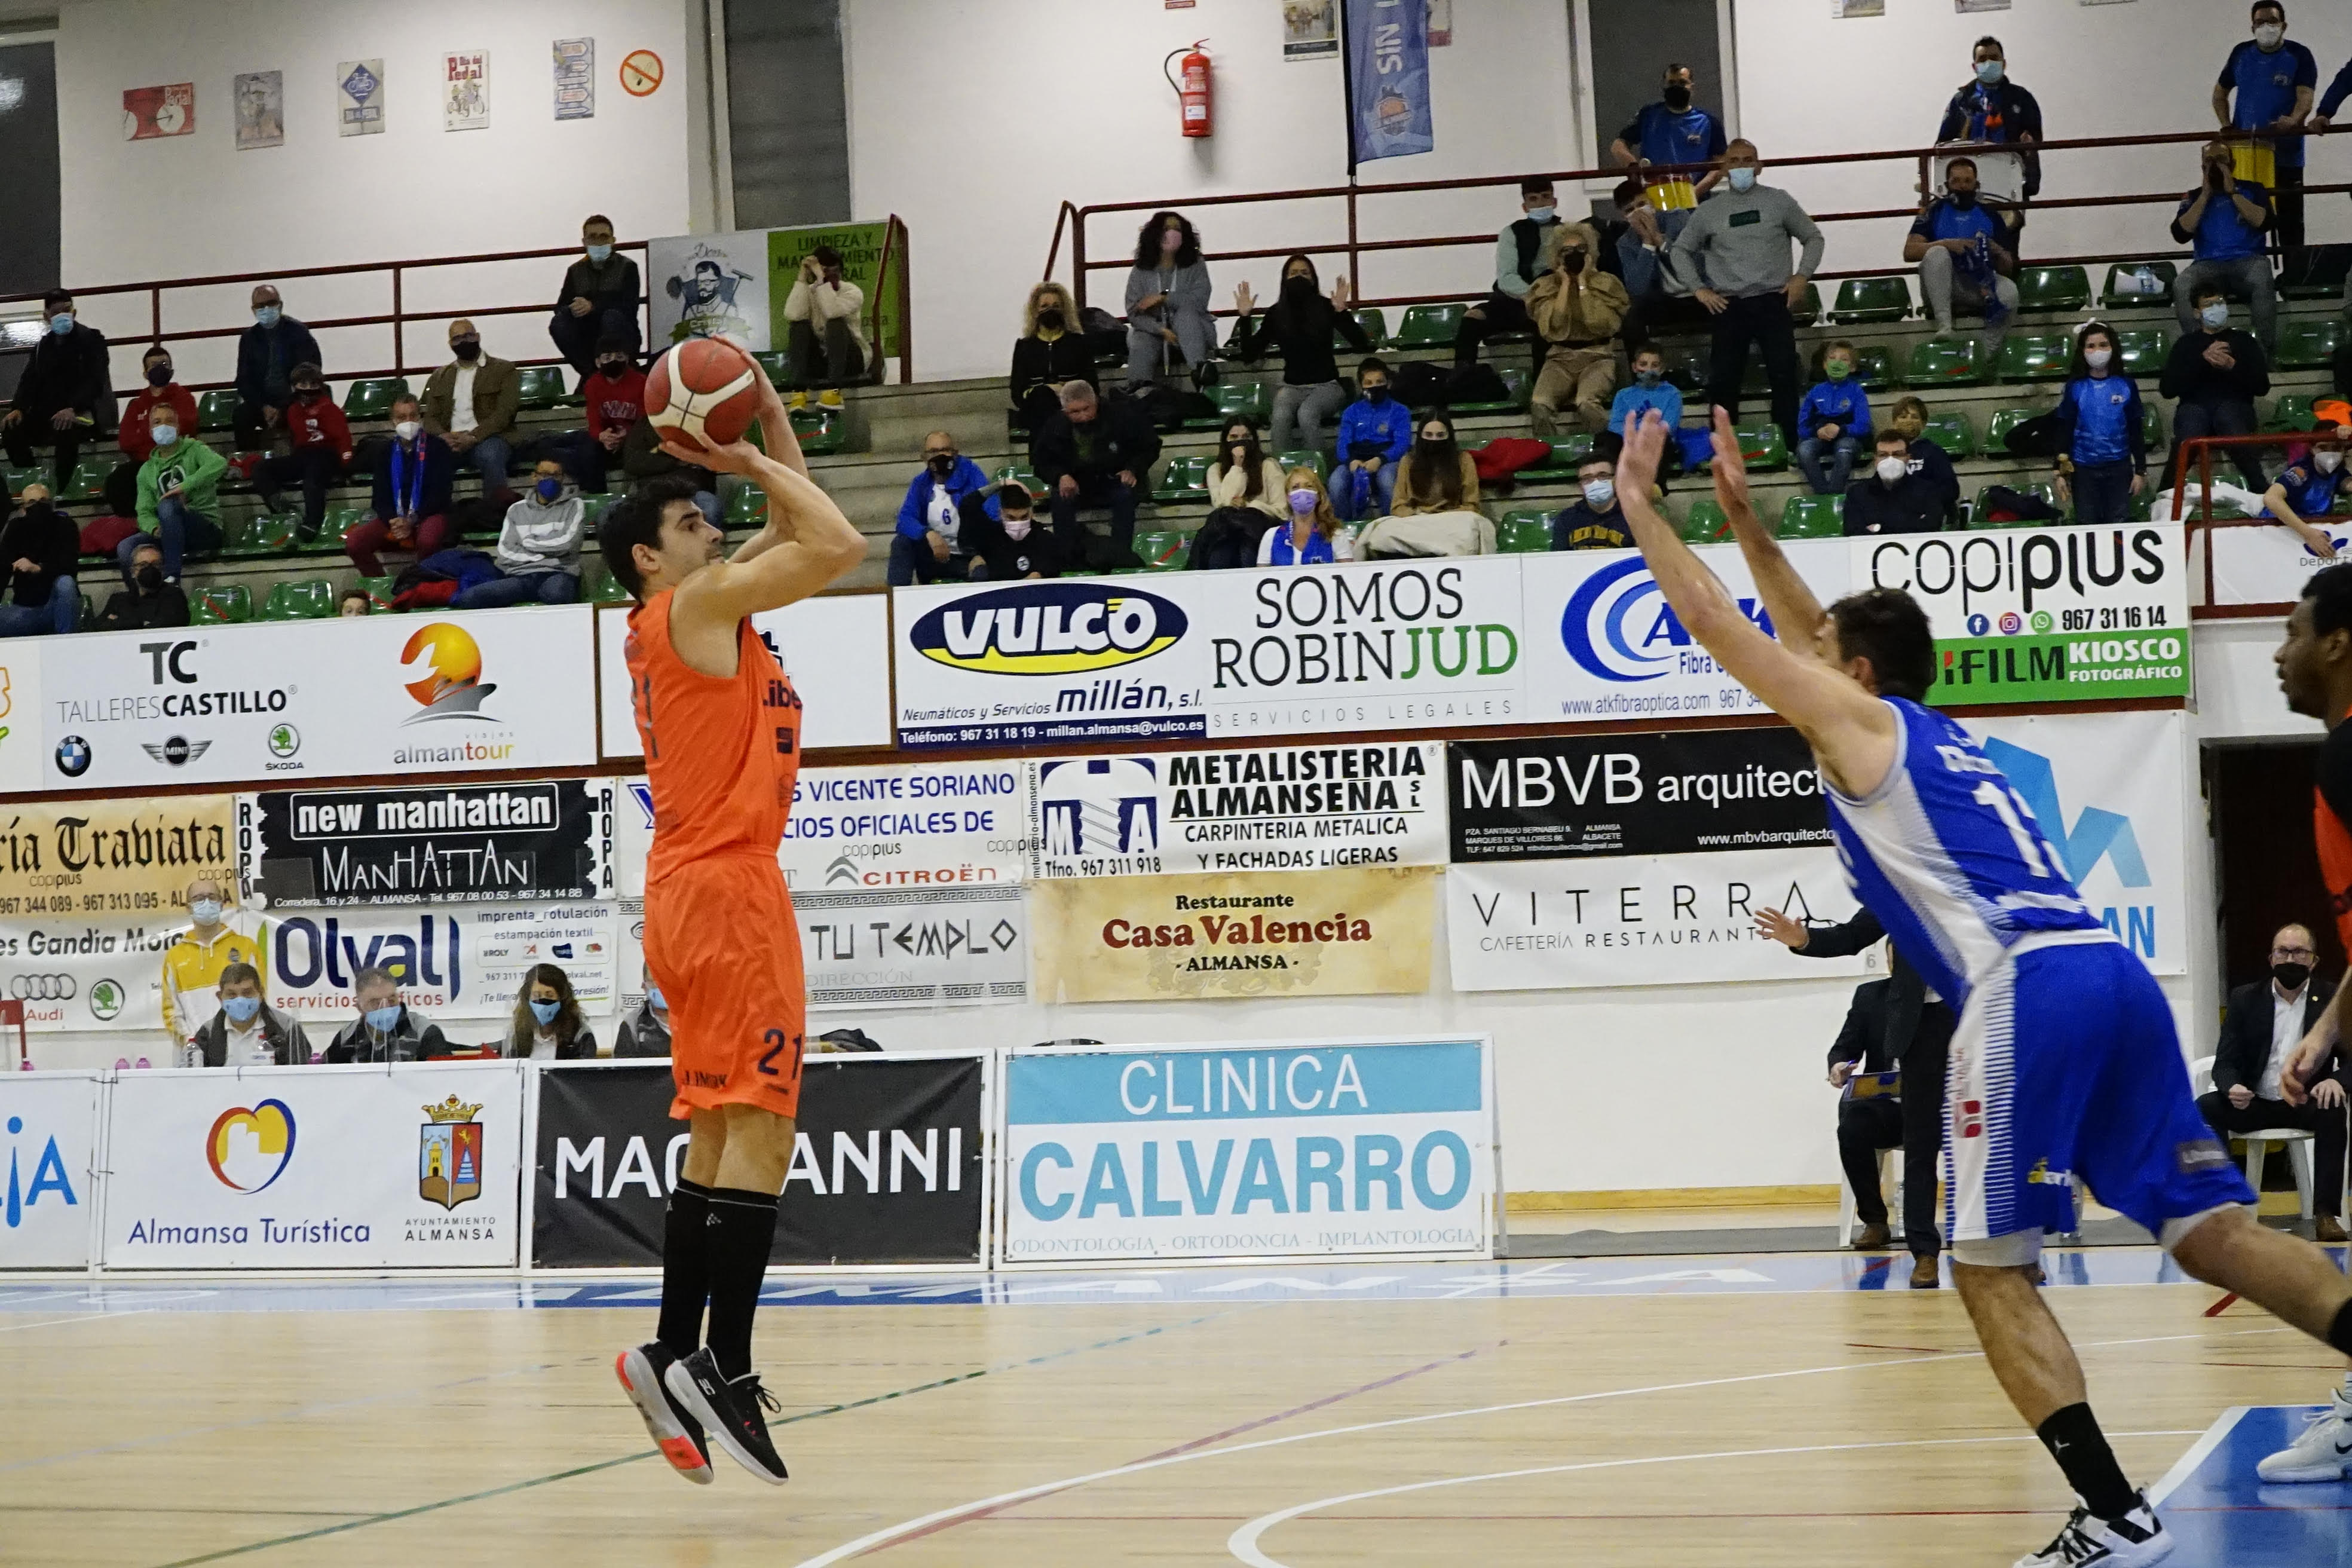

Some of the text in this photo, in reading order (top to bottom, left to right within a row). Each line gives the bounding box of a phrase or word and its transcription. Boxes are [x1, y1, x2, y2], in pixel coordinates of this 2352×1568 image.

[864, 232, 872, 246] Y
[1256, 568, 1463, 629] SOMOS
[942, 598, 1157, 656] VULCO
[2062, 605, 2168, 631] 967 31 16 14
[140, 641, 198, 685] TC
[1211, 624, 1518, 689] ROBINJUD
[1680, 651, 1712, 675] Fibra
[2069, 638, 2181, 663] KIOSCO
[2069, 664, 2183, 682] FOTOGRÁFICO
[903, 705, 975, 721] Neumáticos
[980, 709, 988, 720] y
[993, 702, 1051, 716] Servicios
[1179, 690, 1203, 708] s.l.
[1214, 700, 1513, 728] SERVICIOS LEGALES
[1561, 690, 1711, 715] www.atkfibraoptica.com
[1719, 689, 1742, 708] 967
[464, 731, 514, 740] viajes
[901, 720, 1205, 745] Teléfono: 967 31 18 19 millan.almansa@vulco.es
[165, 746, 188, 756] MINI
[393, 740, 514, 765] almantour
[265, 761, 305, 771] ŠKODA
[1168, 746, 1425, 786] METALISTERIA
[809, 777, 902, 802] VICENTE
[909, 773, 1015, 798] SORIANO
[1462, 753, 1825, 809] MBVB arquitect
[1171, 777, 1399, 818] ALMANSEÑA
[299, 792, 551, 834] new manhattan
[841, 811, 957, 838] OFICIALES
[963, 810, 994, 831] DE
[601, 788, 614, 890] ROPA
[1185, 816, 1408, 843] CARPINTERIA METALICA
[1697, 827, 1835, 846] www.mbvbarquitecto
[1045, 856, 1162, 878] Tfno. 967 311 918
[1197, 846, 1399, 870] Y FACHADAS LIGERAS
[24, 896, 47, 913] 344
[50, 896, 72, 912] 089
[84, 895, 104, 911] 967
[110, 893, 131, 909] 313
[325, 896, 336, 906] 16
[338, 898, 345, 906] y
[346, 896, 359, 905] 24
[370, 894, 421, 905] ALMANSA
[446, 893, 466, 902] 967
[481, 892, 494, 901] 00
[495, 891, 509, 900] 53
[517, 889, 537, 899] 967
[538, 889, 552, 898] 34
[553, 888, 566, 898] 14
[1175, 893, 1295, 911] Restaurante
[1472, 880, 1811, 927] VITERRA
[28, 929, 117, 956] Gandia
[494, 927, 593, 941] estampación textil
[810, 918, 1018, 961] TU TEMPLO
[1102, 912, 1372, 948] Casa Valencia
[1480, 930, 1573, 952] CAFETERÍA
[1186, 954, 1288, 972] ALMANSA
[485, 972, 501, 981] 967
[503, 972, 517, 980] 311
[277, 992, 359, 1009] servicios
[24, 1008, 63, 1021] Audi
[757, 1028, 802, 1081] 21
[1119, 1054, 1368, 1116] CLINICA
[555, 1127, 962, 1199] MAANNI
[1019, 1129, 1471, 1222] CALVARRO
[127, 1218, 370, 1245] Almansa Turística
[405, 1217, 497, 1227] AYUNTAMIENTO
[405, 1229, 495, 1241] ALMANSA
[1012, 1228, 1475, 1254] ODONTOLOGIA ORTODONCIA IMPLANTOLOGIA
